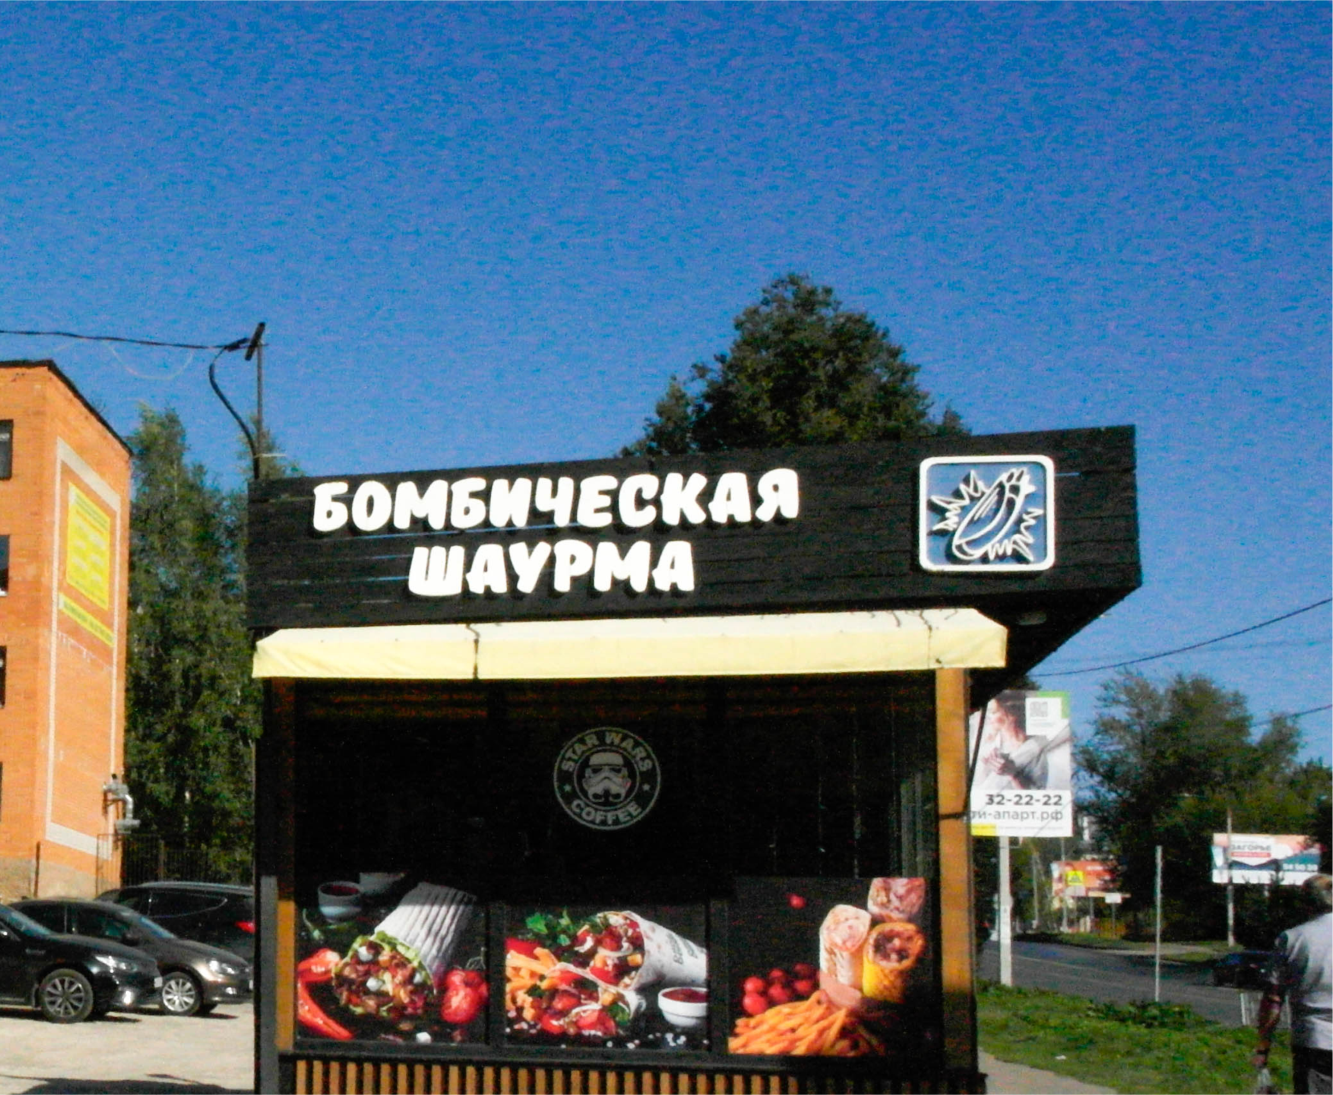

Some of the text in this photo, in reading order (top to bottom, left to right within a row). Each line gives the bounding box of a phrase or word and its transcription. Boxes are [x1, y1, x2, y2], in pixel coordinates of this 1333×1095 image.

[313, 468, 799, 532] БОМБИЧЕСКАЯ
[408, 539, 695, 597] ШАУРМА
[561, 732, 653, 772] STAR WARS
[571, 800, 642, 825] COFFEE
[985, 794, 1063, 807] 32-22-22
